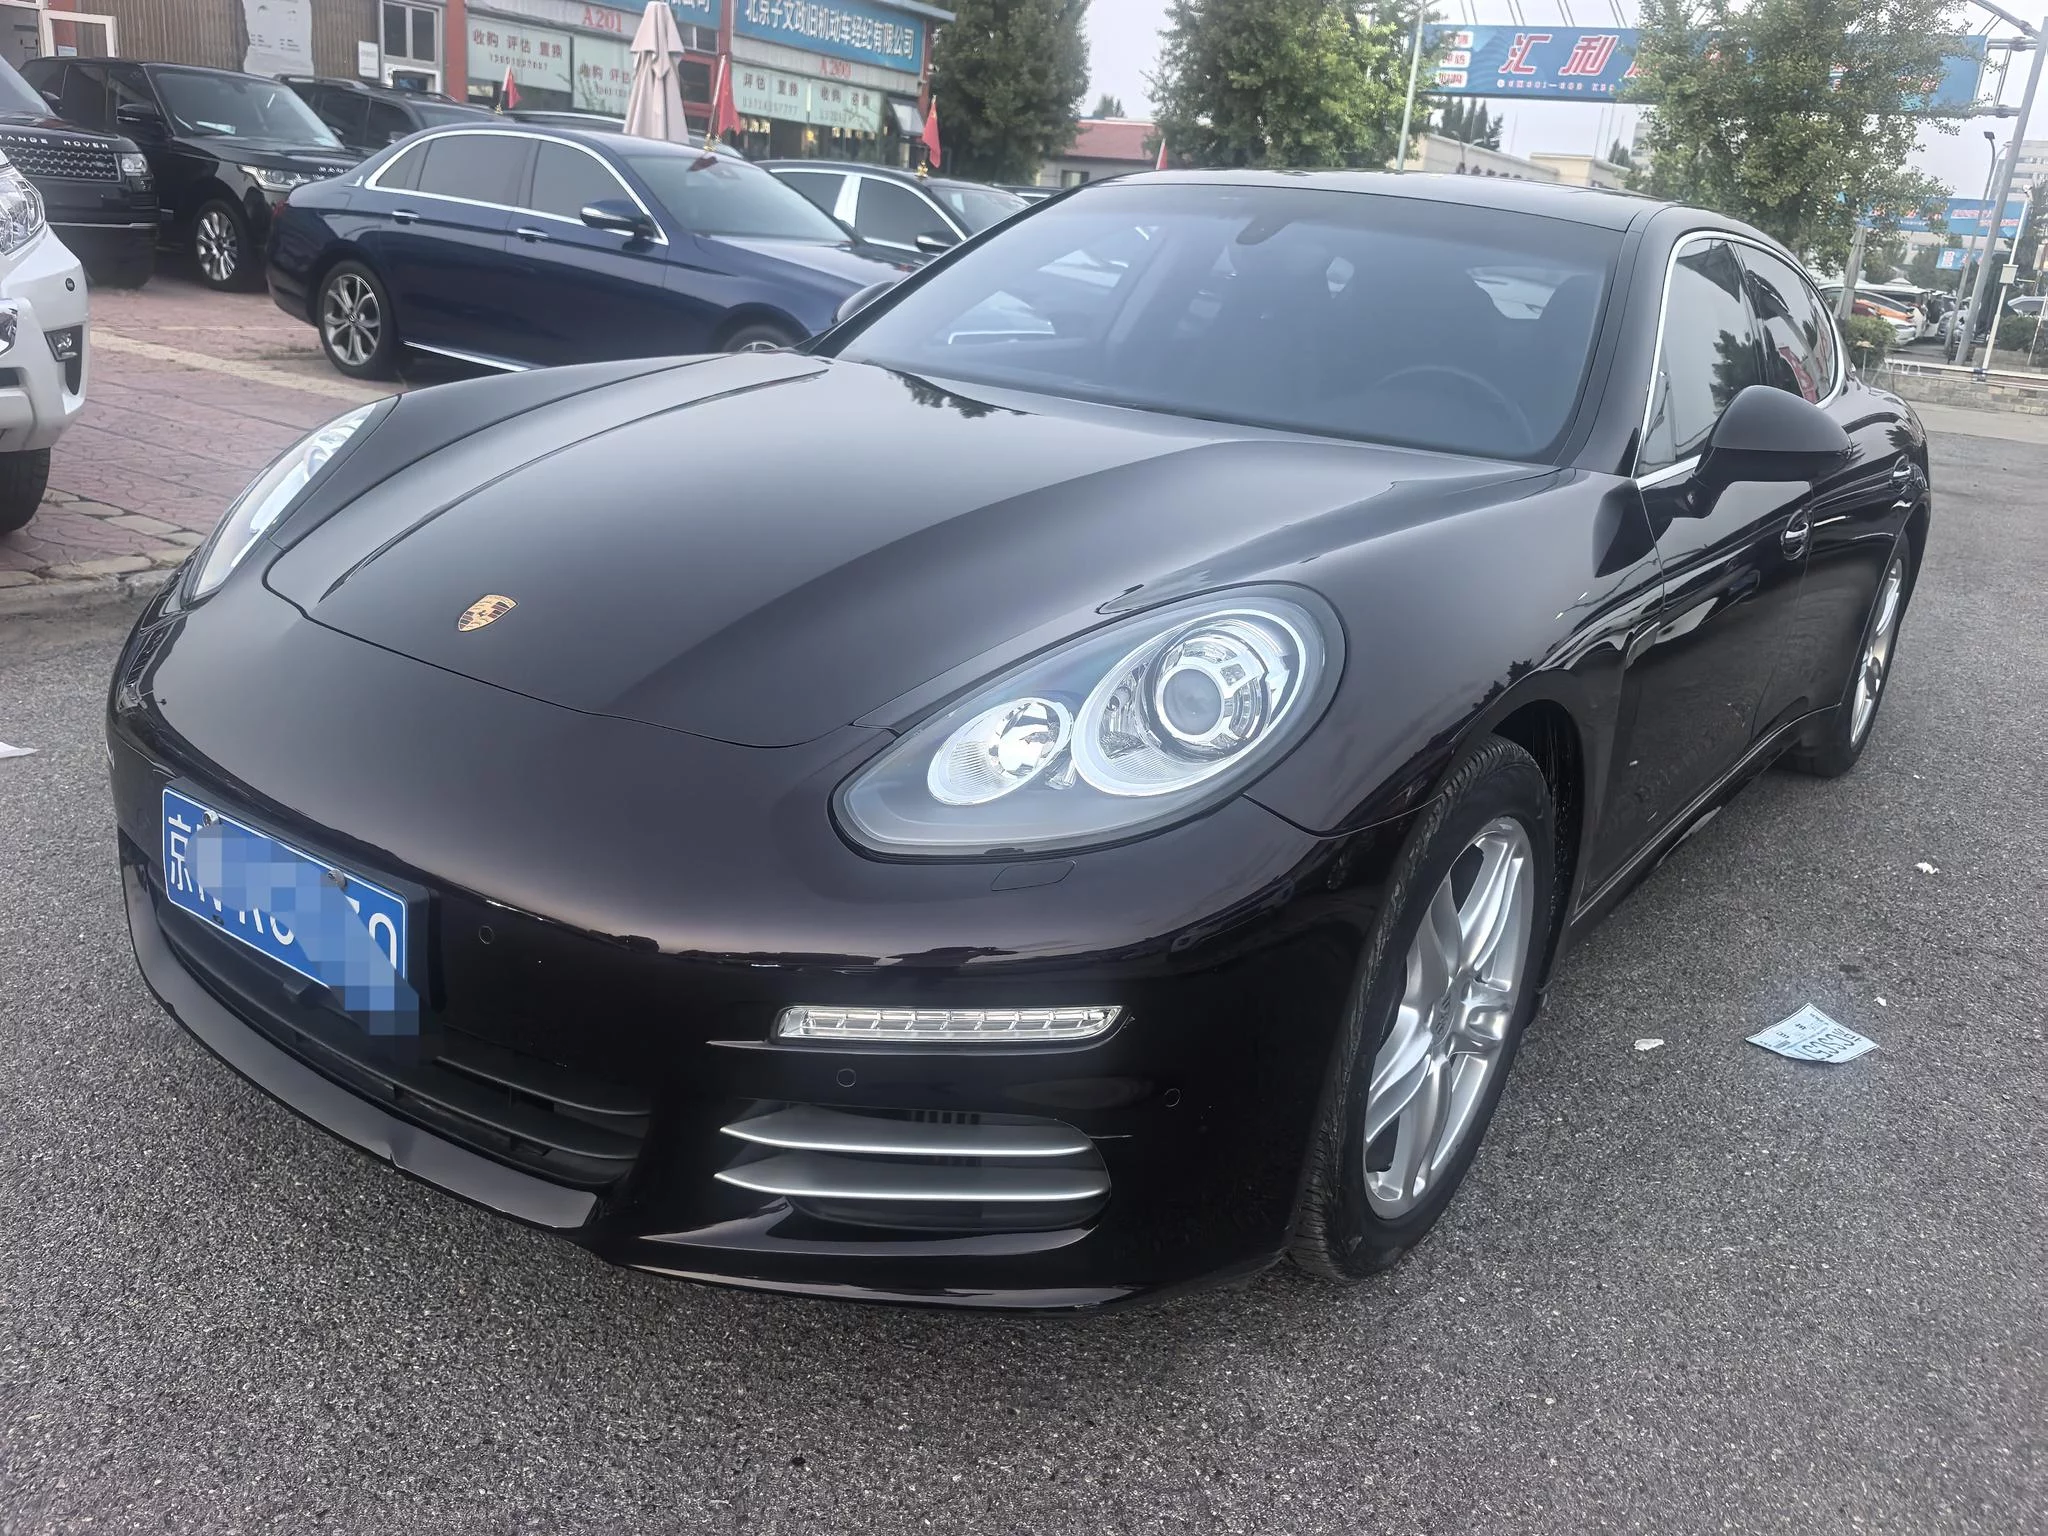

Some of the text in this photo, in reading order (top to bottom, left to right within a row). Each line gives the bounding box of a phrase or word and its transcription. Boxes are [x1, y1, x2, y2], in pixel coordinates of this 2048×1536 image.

[583, 8, 623, 33] A201
[473, 29, 499, 48] 收购
[506, 35, 531, 54] 评估
[0, 134, 109, 149] ANGE ROVER
